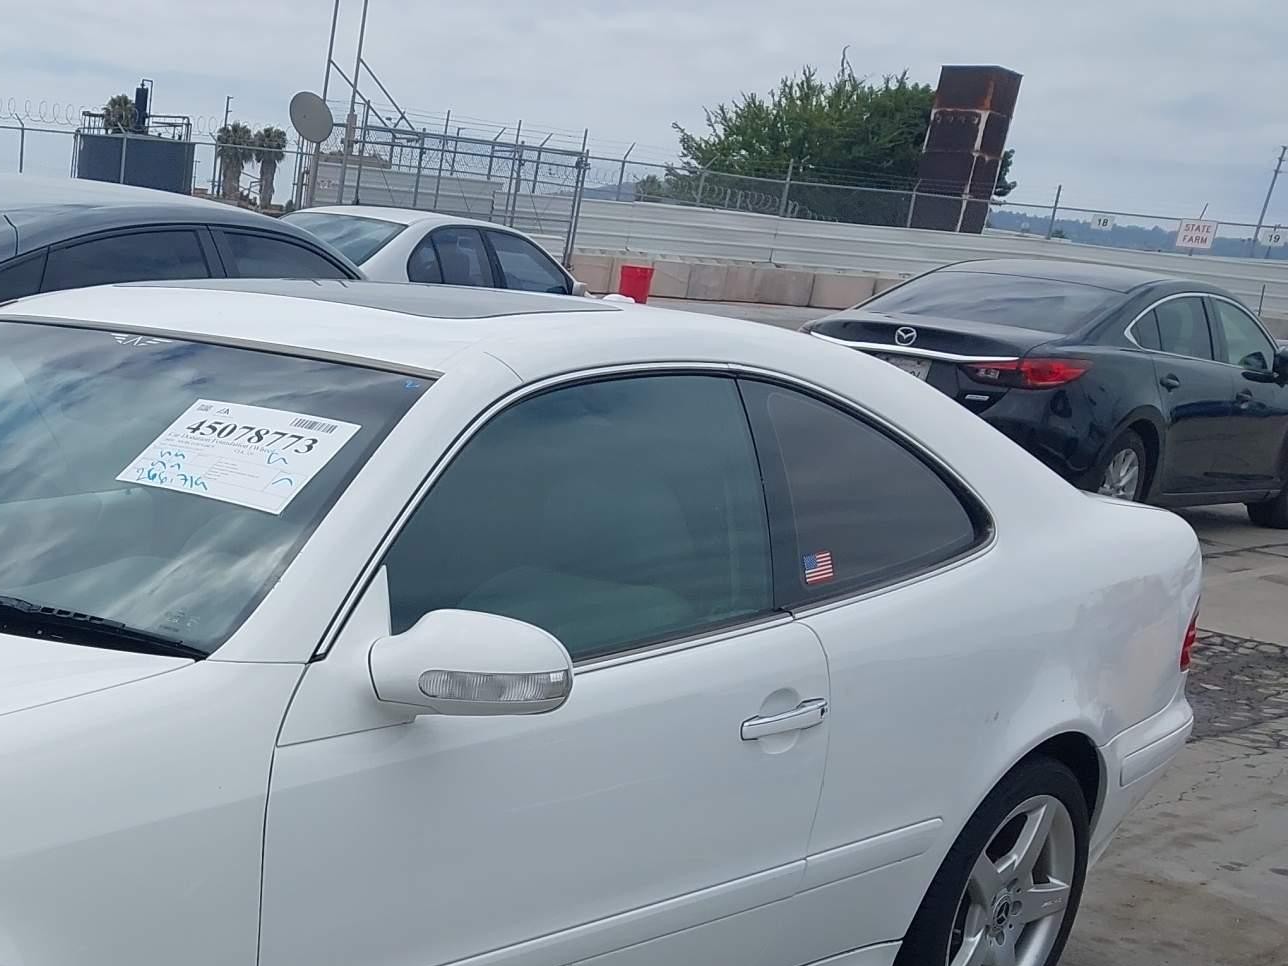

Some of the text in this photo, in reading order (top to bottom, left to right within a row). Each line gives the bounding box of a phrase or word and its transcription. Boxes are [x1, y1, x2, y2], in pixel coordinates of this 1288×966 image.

[1096, 217, 1109, 228] 18
[1183, 222, 1213, 235] STATE
[1181, 234, 1209, 246] FARM
[1267, 233, 1282, 244] 19
[185, 418, 320, 455] 45078773
